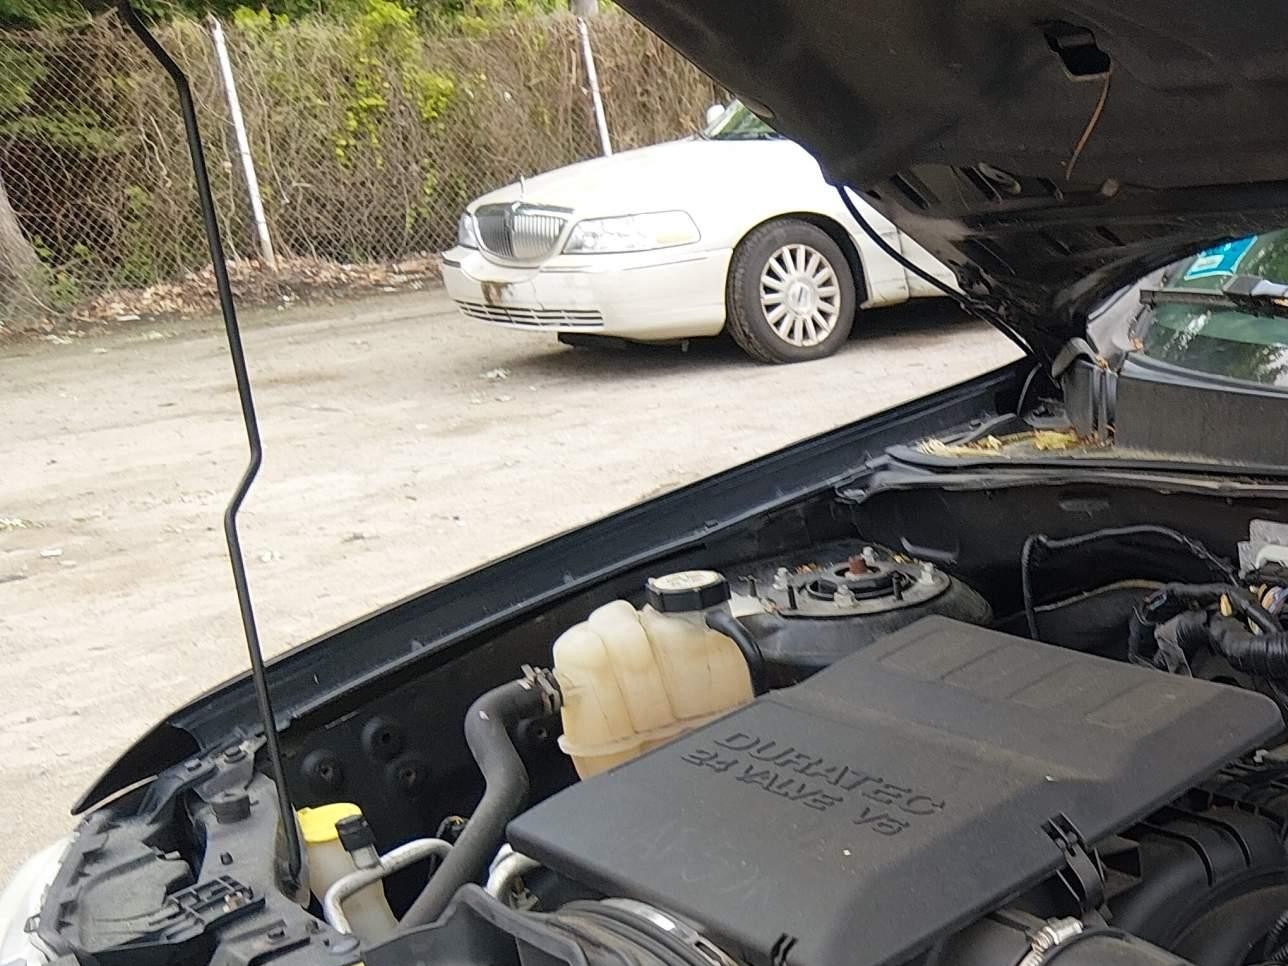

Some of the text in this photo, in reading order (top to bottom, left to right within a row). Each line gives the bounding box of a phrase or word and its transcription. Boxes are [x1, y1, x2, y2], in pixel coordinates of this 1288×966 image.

[713, 732, 946, 816] DURATEC
[735, 764, 844, 812] VALVE
[852, 806, 911, 836] V6
